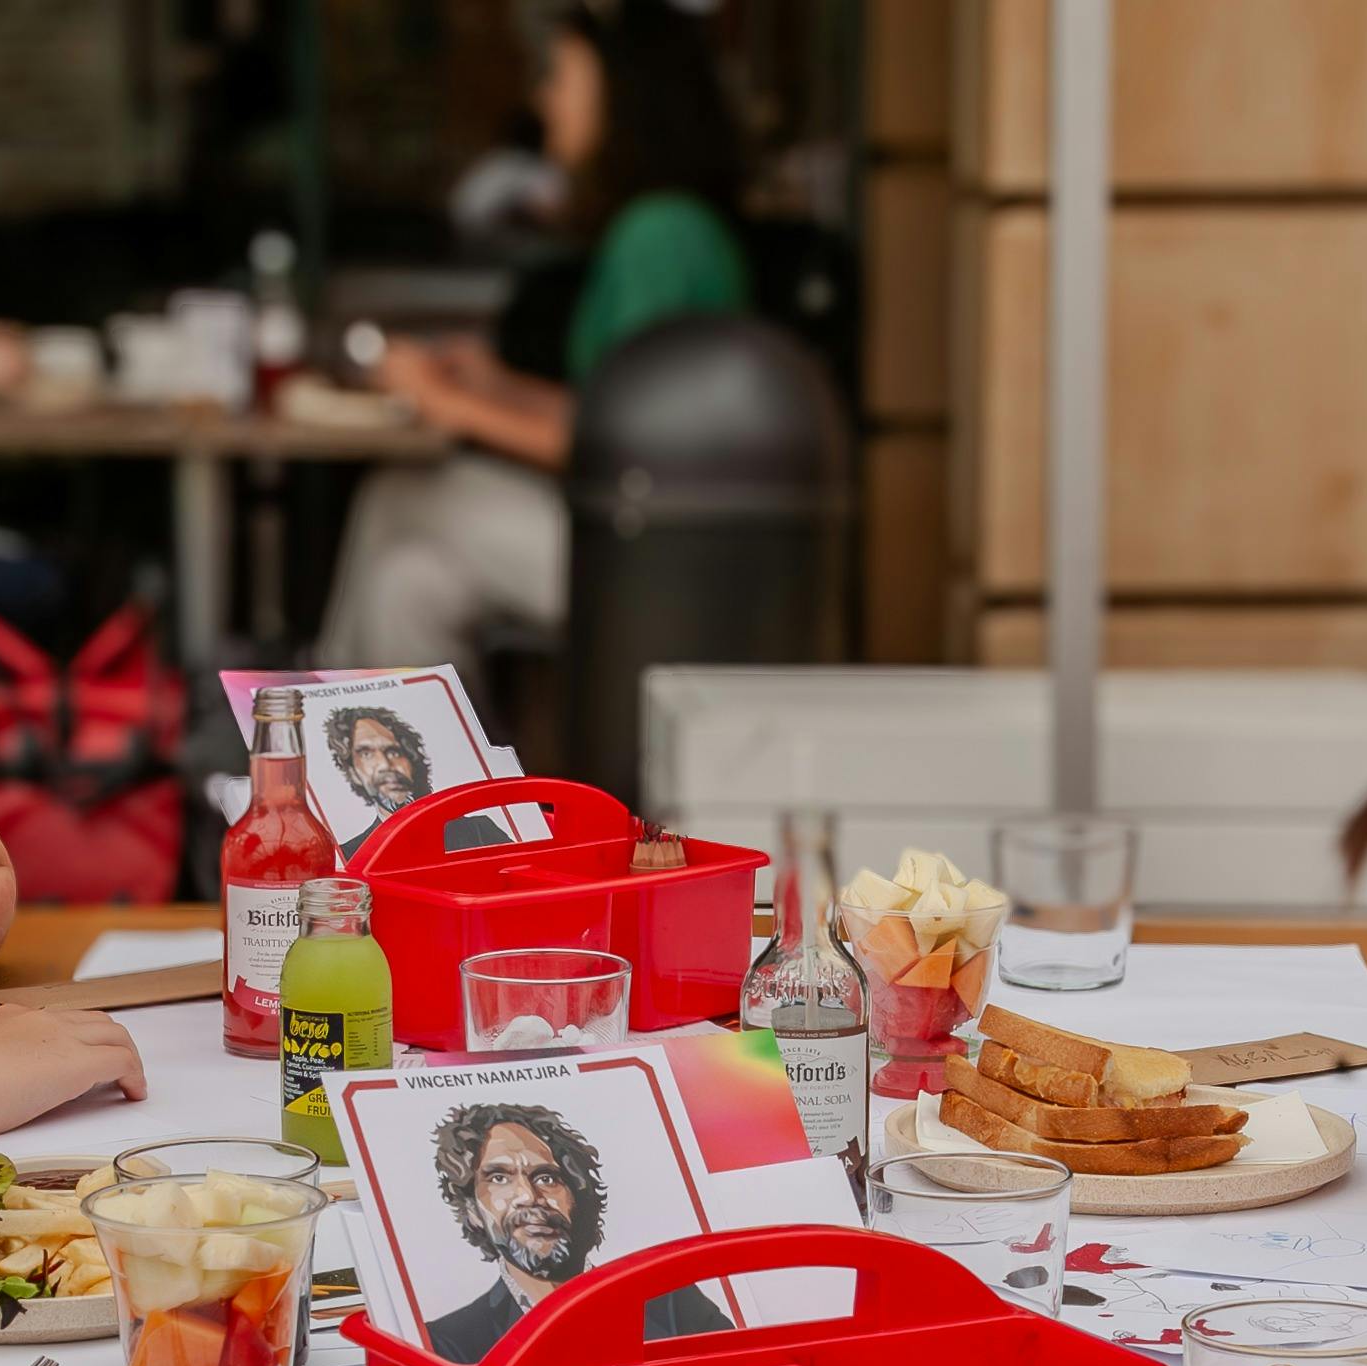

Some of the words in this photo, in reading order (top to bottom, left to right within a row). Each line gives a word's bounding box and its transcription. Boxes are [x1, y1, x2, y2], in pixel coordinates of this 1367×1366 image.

[343, 680, 398, 694] NAMATJIRA
[247, 910, 299, 927] Bickfo
[405, 1073, 474, 1090] VINCENT
[477, 1064, 571, 1085] NAMATJIRA
[785, 1061, 846, 1083] kford's
[308, 1094, 328, 1104] GRE
[824, 1092, 852, 1106] SODA
[307, 1105, 331, 1116] FRUI
